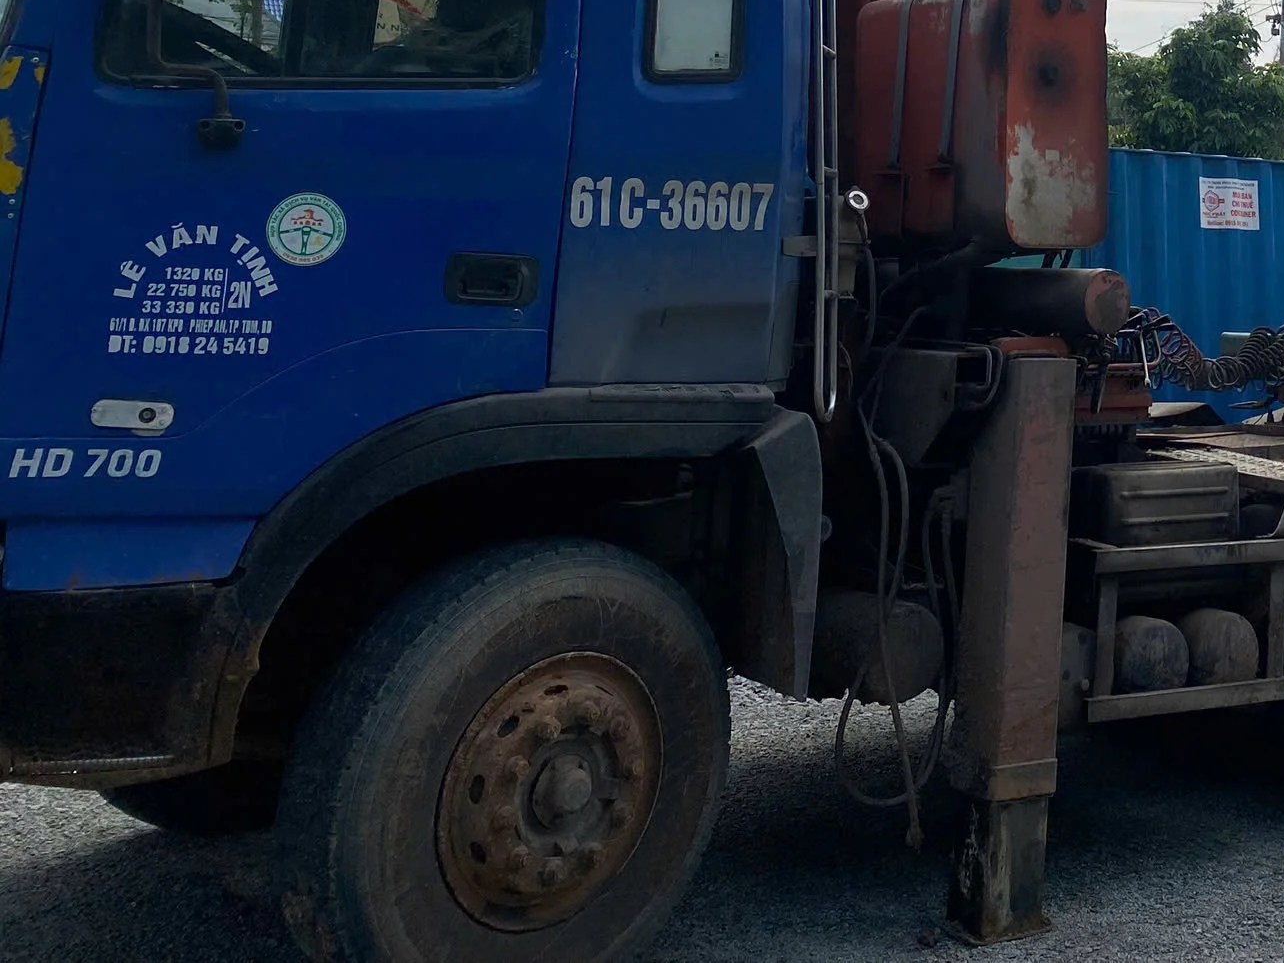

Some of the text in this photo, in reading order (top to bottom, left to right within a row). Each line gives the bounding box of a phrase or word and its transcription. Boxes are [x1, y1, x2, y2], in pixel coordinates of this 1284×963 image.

[570, 176, 775, 231] 61C-36607
[113, 222, 279, 299] LÊ VĂN TỊNH
[165, 267, 224, 281] 1320 KG
[146, 283, 222, 298] 22 750 KG
[228, 281, 252, 308] 2N
[142, 300, 220, 314] 33 330 KG
[143, 335, 190, 354] 0918
[8, 448, 162, 479] HD 700
